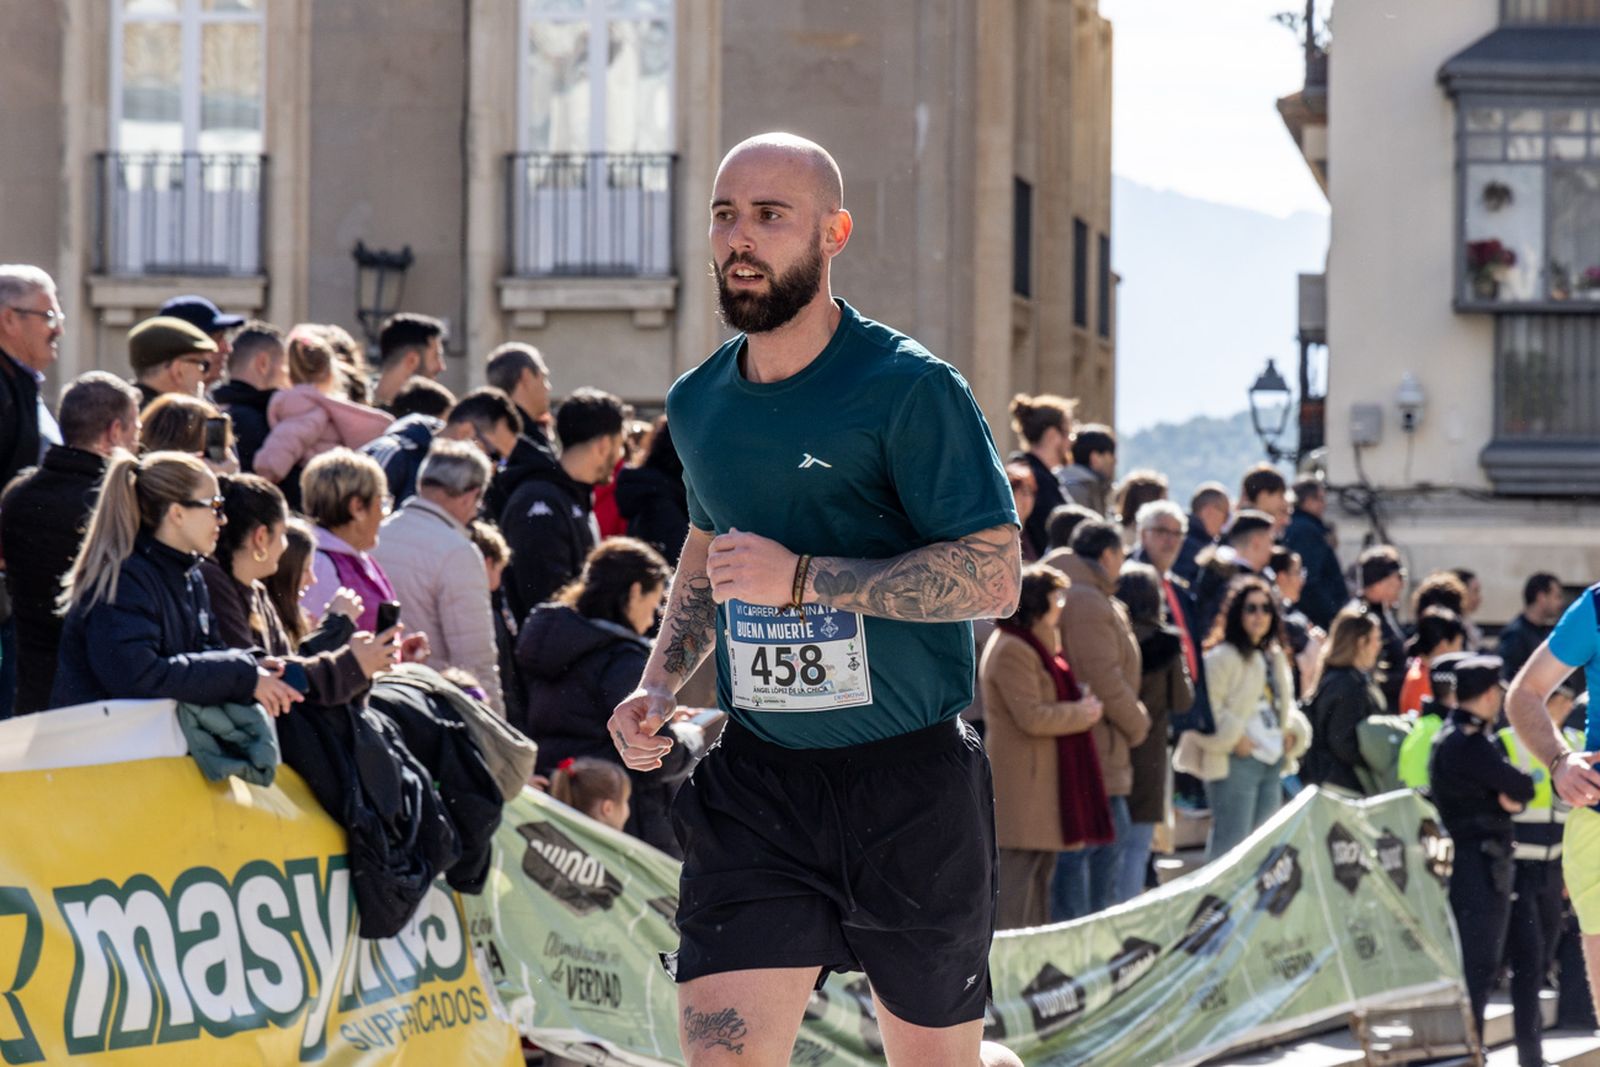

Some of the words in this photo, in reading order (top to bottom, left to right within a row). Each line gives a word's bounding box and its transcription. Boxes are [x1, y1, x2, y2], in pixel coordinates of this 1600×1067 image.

[736, 620, 765, 639] BUENA
[766, 622, 815, 640] MUERTE
[751, 644, 826, 687] 458
